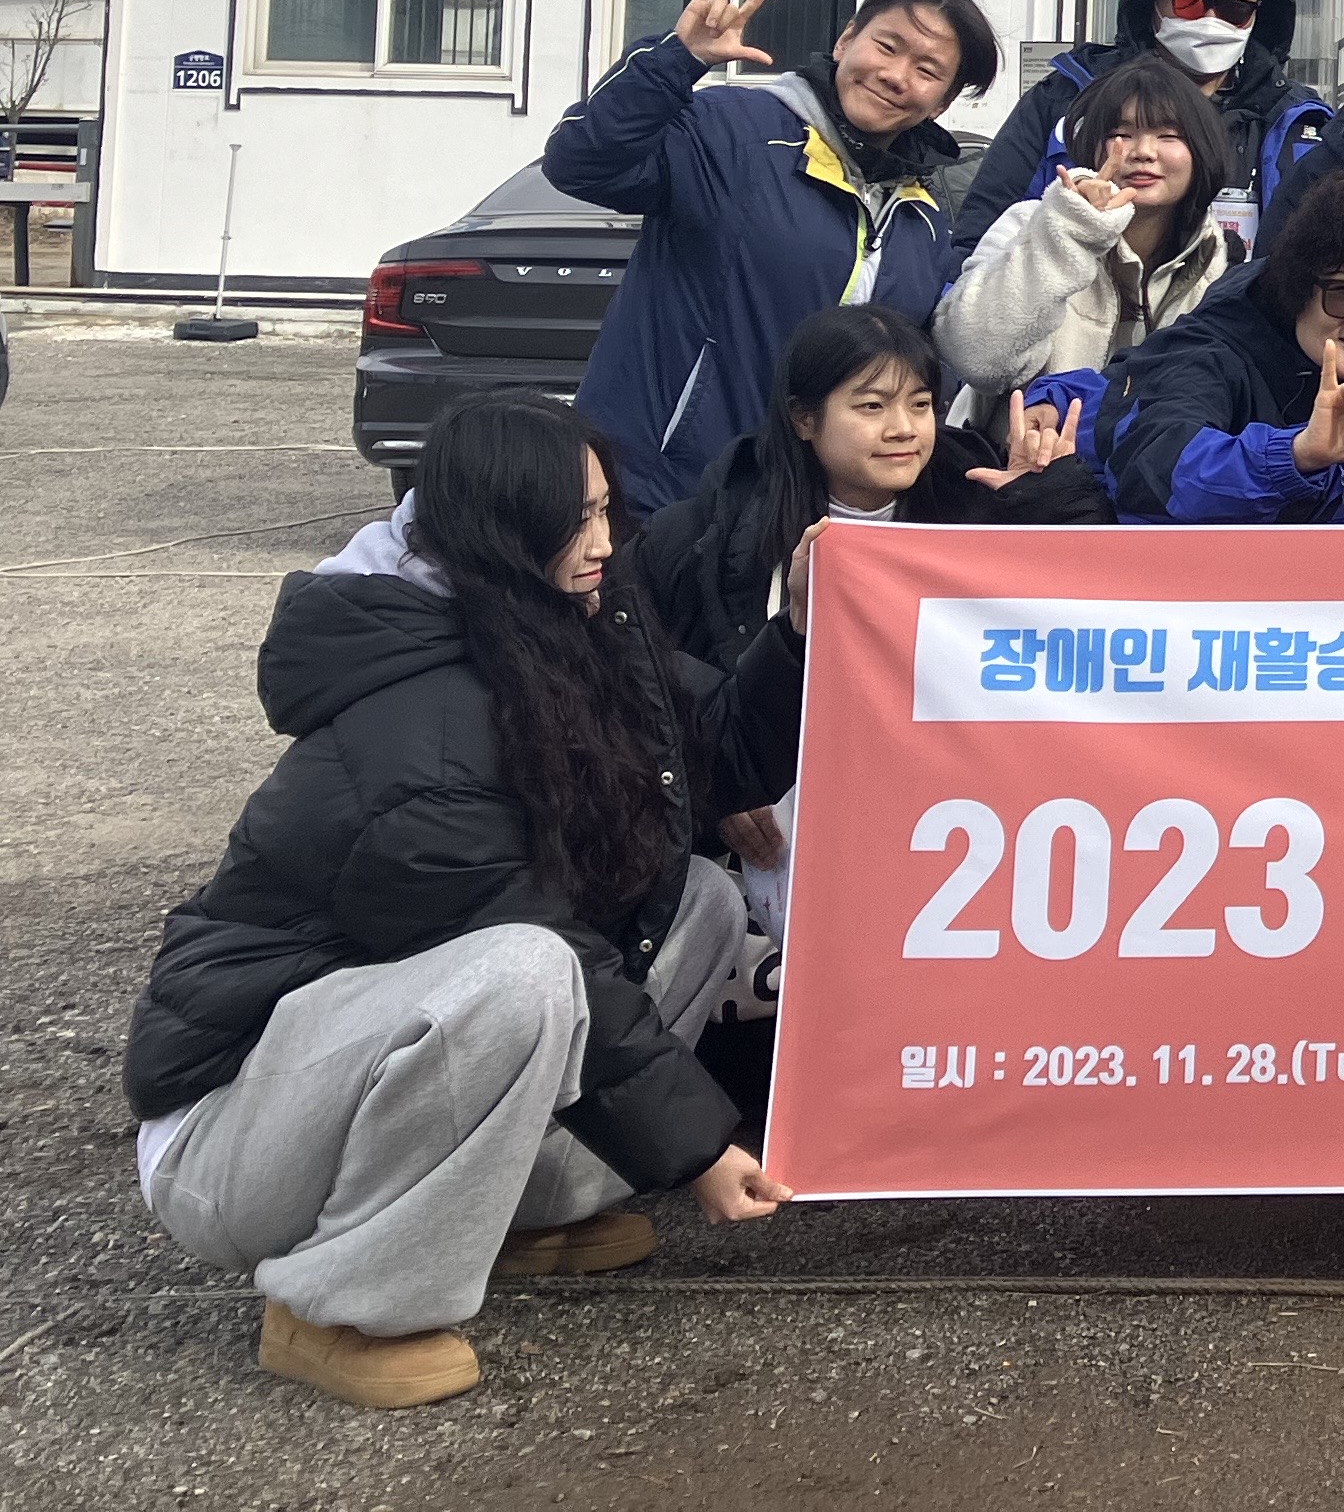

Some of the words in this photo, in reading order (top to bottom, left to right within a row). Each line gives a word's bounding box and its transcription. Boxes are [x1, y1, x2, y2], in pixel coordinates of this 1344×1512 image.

[176, 70, 221, 87] 1206
[980, 627, 1168, 694] 장애인
[902, 797, 1325, 960] 2023
[901, 1045, 977, 1089] 일시
[1022, 1044, 1137, 1087] 2023.
[1153, 1044, 1213, 1086] 11.
